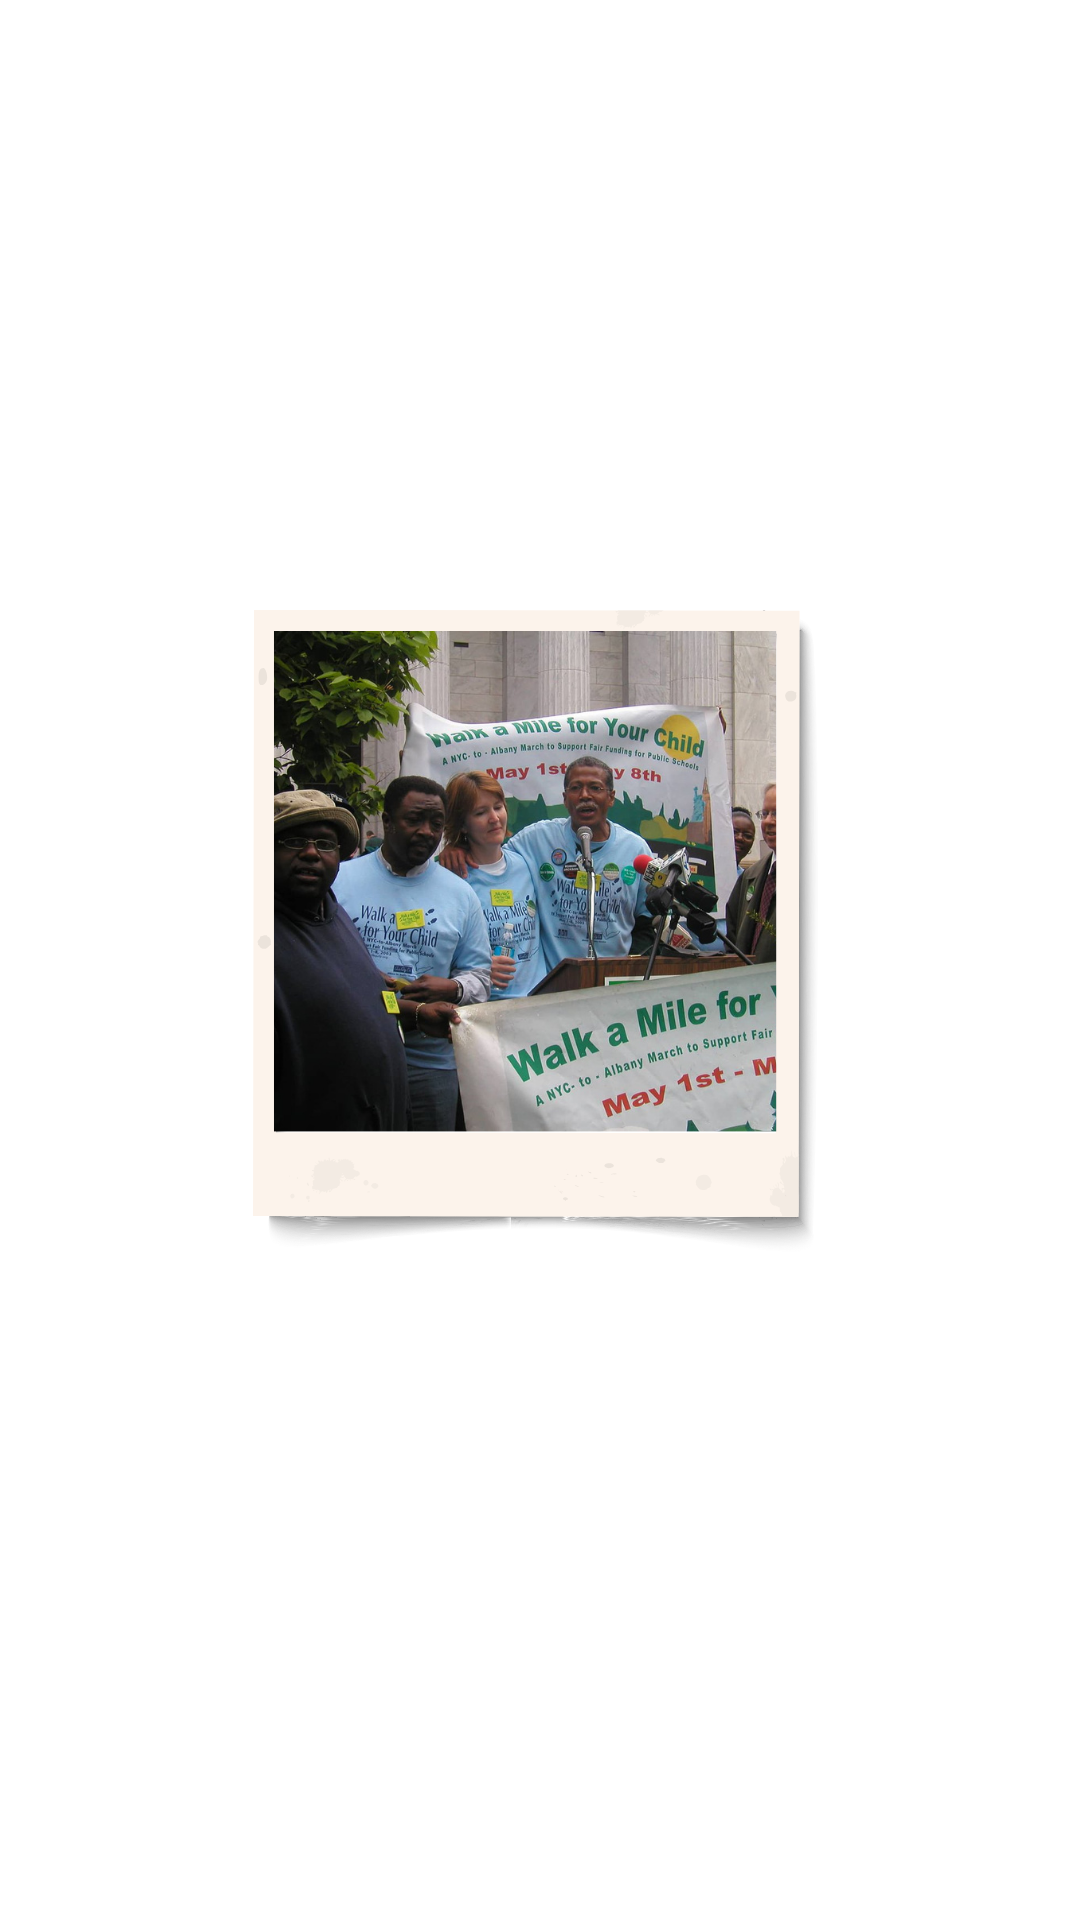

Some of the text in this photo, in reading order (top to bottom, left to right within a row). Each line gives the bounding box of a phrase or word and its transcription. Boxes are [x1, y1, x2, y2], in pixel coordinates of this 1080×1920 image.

[425, 717, 705, 758] Walk a Mile for Your Child
[442, 757, 448, 766] A
[491, 746, 518, 756] Albany
[520, 743, 544, 752] March
[558, 742, 586, 751] Support
[589, 743, 603, 752] Fair
[605, 745, 633, 757] Funding
[634, 749, 645, 757] for
[648, 752, 669, 763] Public
[672, 757, 699, 771] Schools
[486, 766, 529, 780] May
[536, 763, 567, 775] 1st
[631, 767, 661, 782] 8th
[361, 905, 387, 923] Walk
[389, 913, 396, 924] a
[504, 910, 509, 920] a
[510, 902, 528, 918] Mile
[559, 894, 573, 909] for
[364, 921, 438, 947] for Your Child
[489, 923, 500, 938] for
[507, 990, 761, 1082] Walk a Mile for
[535, 1095, 544, 1107] A
[546, 1082, 575, 1101] NYC-
[578, 1076, 591, 1087] to
[604, 1058, 643, 1078] Albany
[647, 1045, 683, 1063] March
[687, 1042, 699, 1053] to
[703, 1031, 747, 1049] Support
[751, 1028, 773, 1040] Fair
[602, 1084, 666, 1118] May
[677, 1066, 726, 1092] 1st
